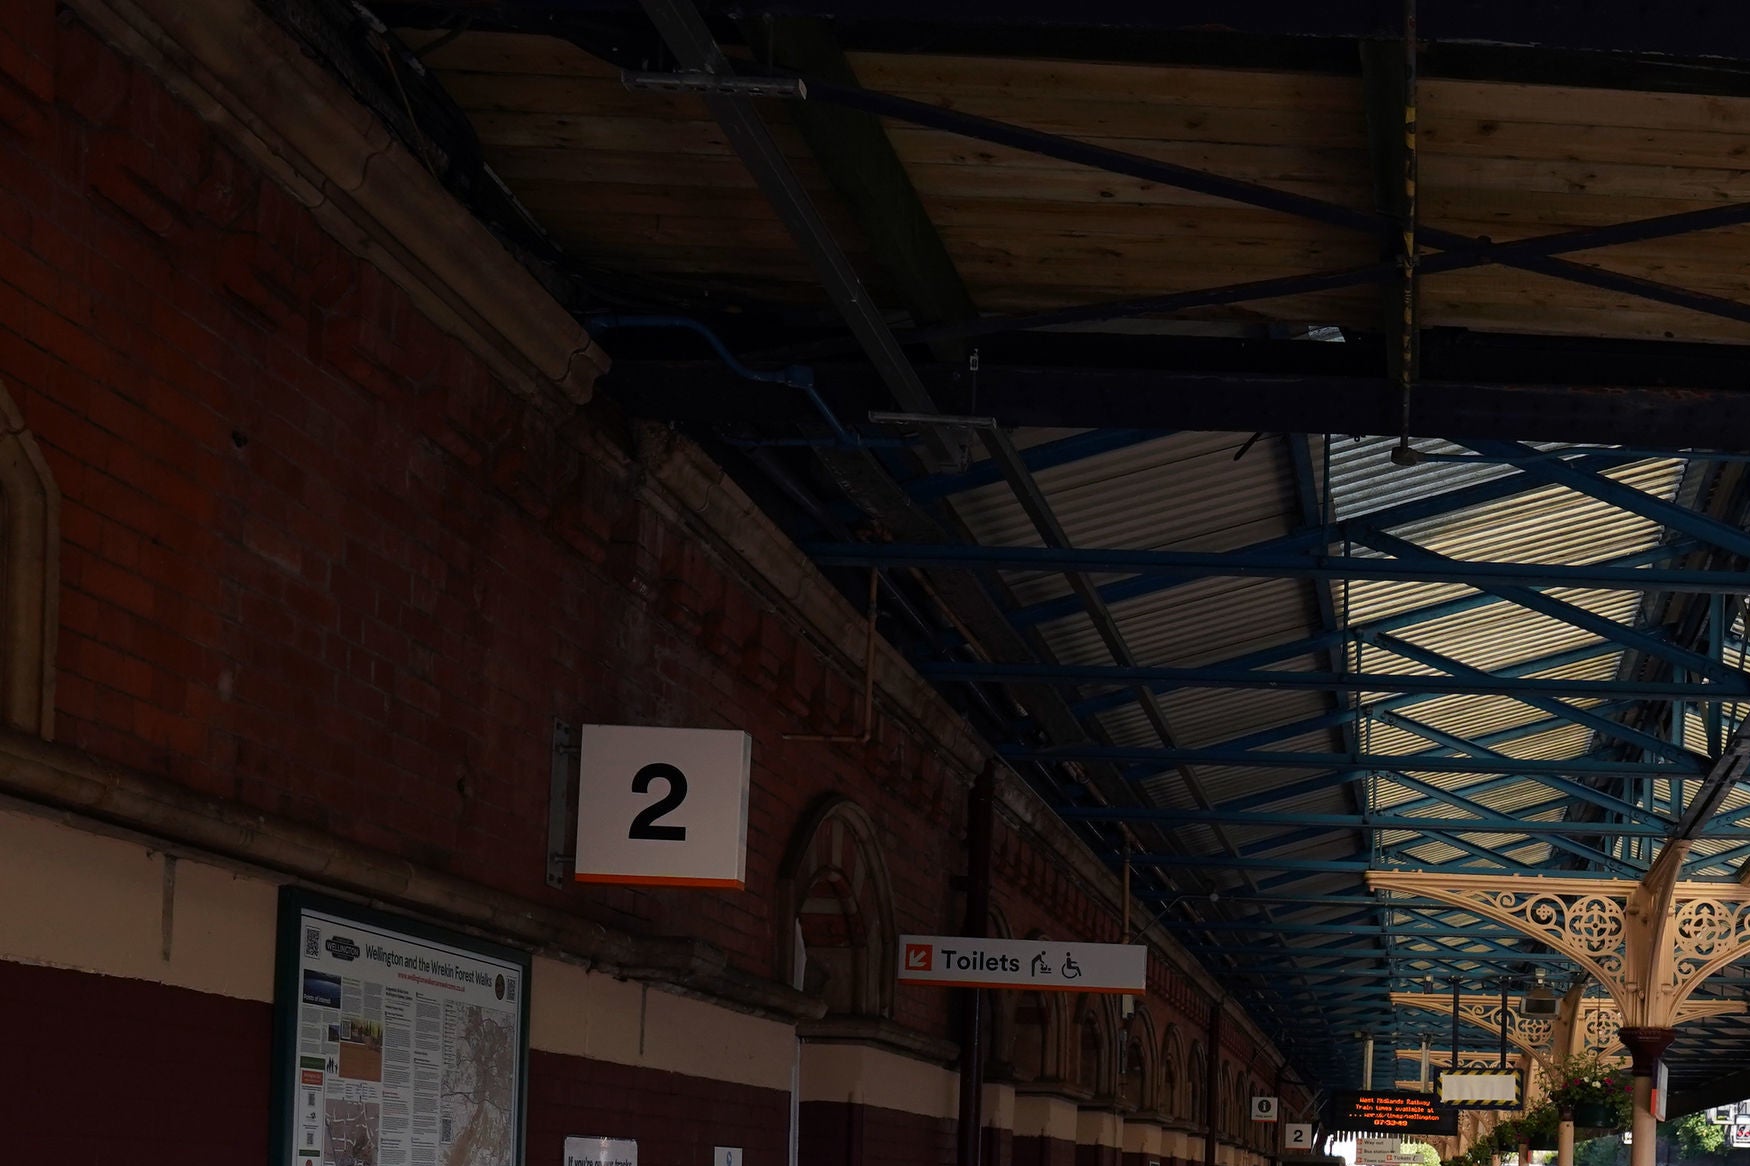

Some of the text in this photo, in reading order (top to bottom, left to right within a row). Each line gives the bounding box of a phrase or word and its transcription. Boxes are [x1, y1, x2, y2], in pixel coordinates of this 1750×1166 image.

[628, 762, 688, 842] 2
[327, 941, 360, 957] WELLINGTON
[941, 949, 1020, 973] Toilets
[365, 943, 493, 987] Wellington and the Wrekin Forest Walks
[1293, 1129, 1303, 1142] 2
